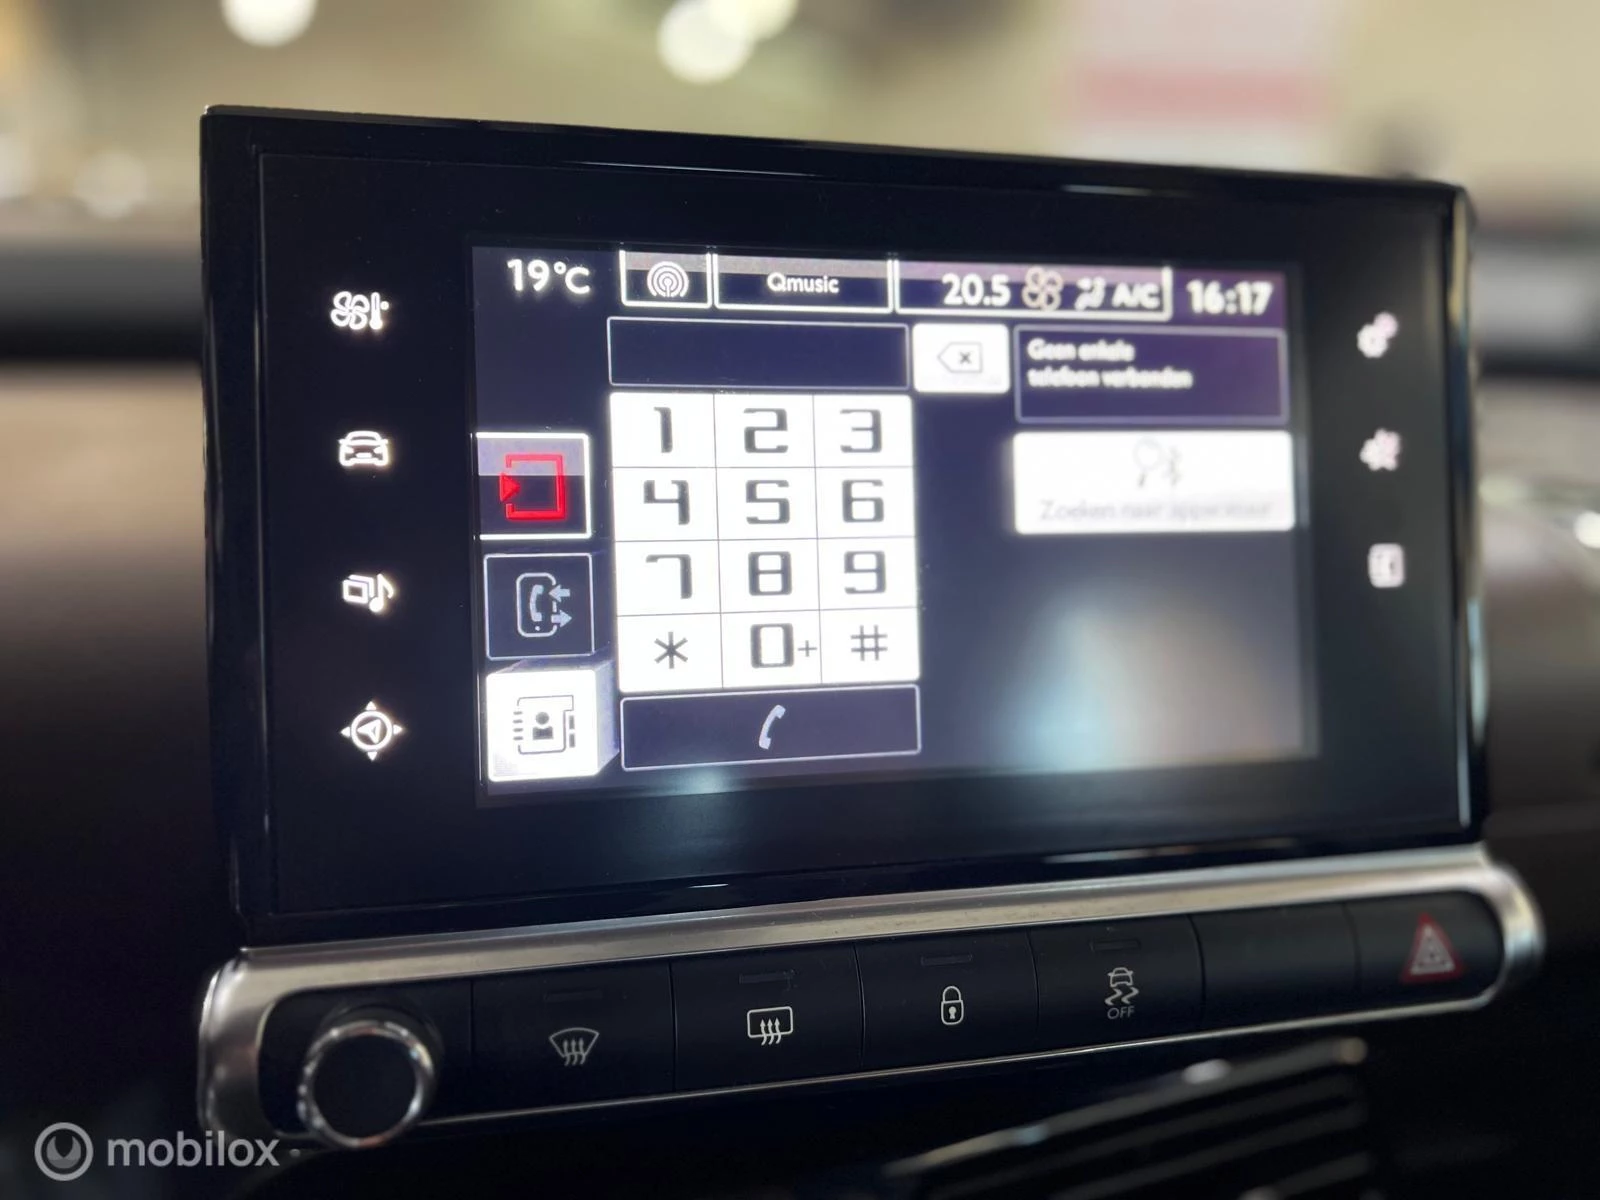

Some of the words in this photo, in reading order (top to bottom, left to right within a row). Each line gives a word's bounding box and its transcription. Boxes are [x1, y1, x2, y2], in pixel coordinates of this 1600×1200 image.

[766, 271, 840, 295] Qmusic
[942, 273, 1012, 307] 20.5
[1187, 279, 1274, 316] 16:17
[653, 406, 674, 453] 1
[742, 407, 789, 453] 2
[839, 408, 883, 453] 3
[643, 479, 691, 526] 4
[745, 479, 791, 525] 5
[841, 479, 885, 523] 6
[645, 553, 693, 600] 7
[747, 551, 793, 597] 8
[843, 550, 887, 595] 9
[1107, 1006, 1135, 1020] OFF
